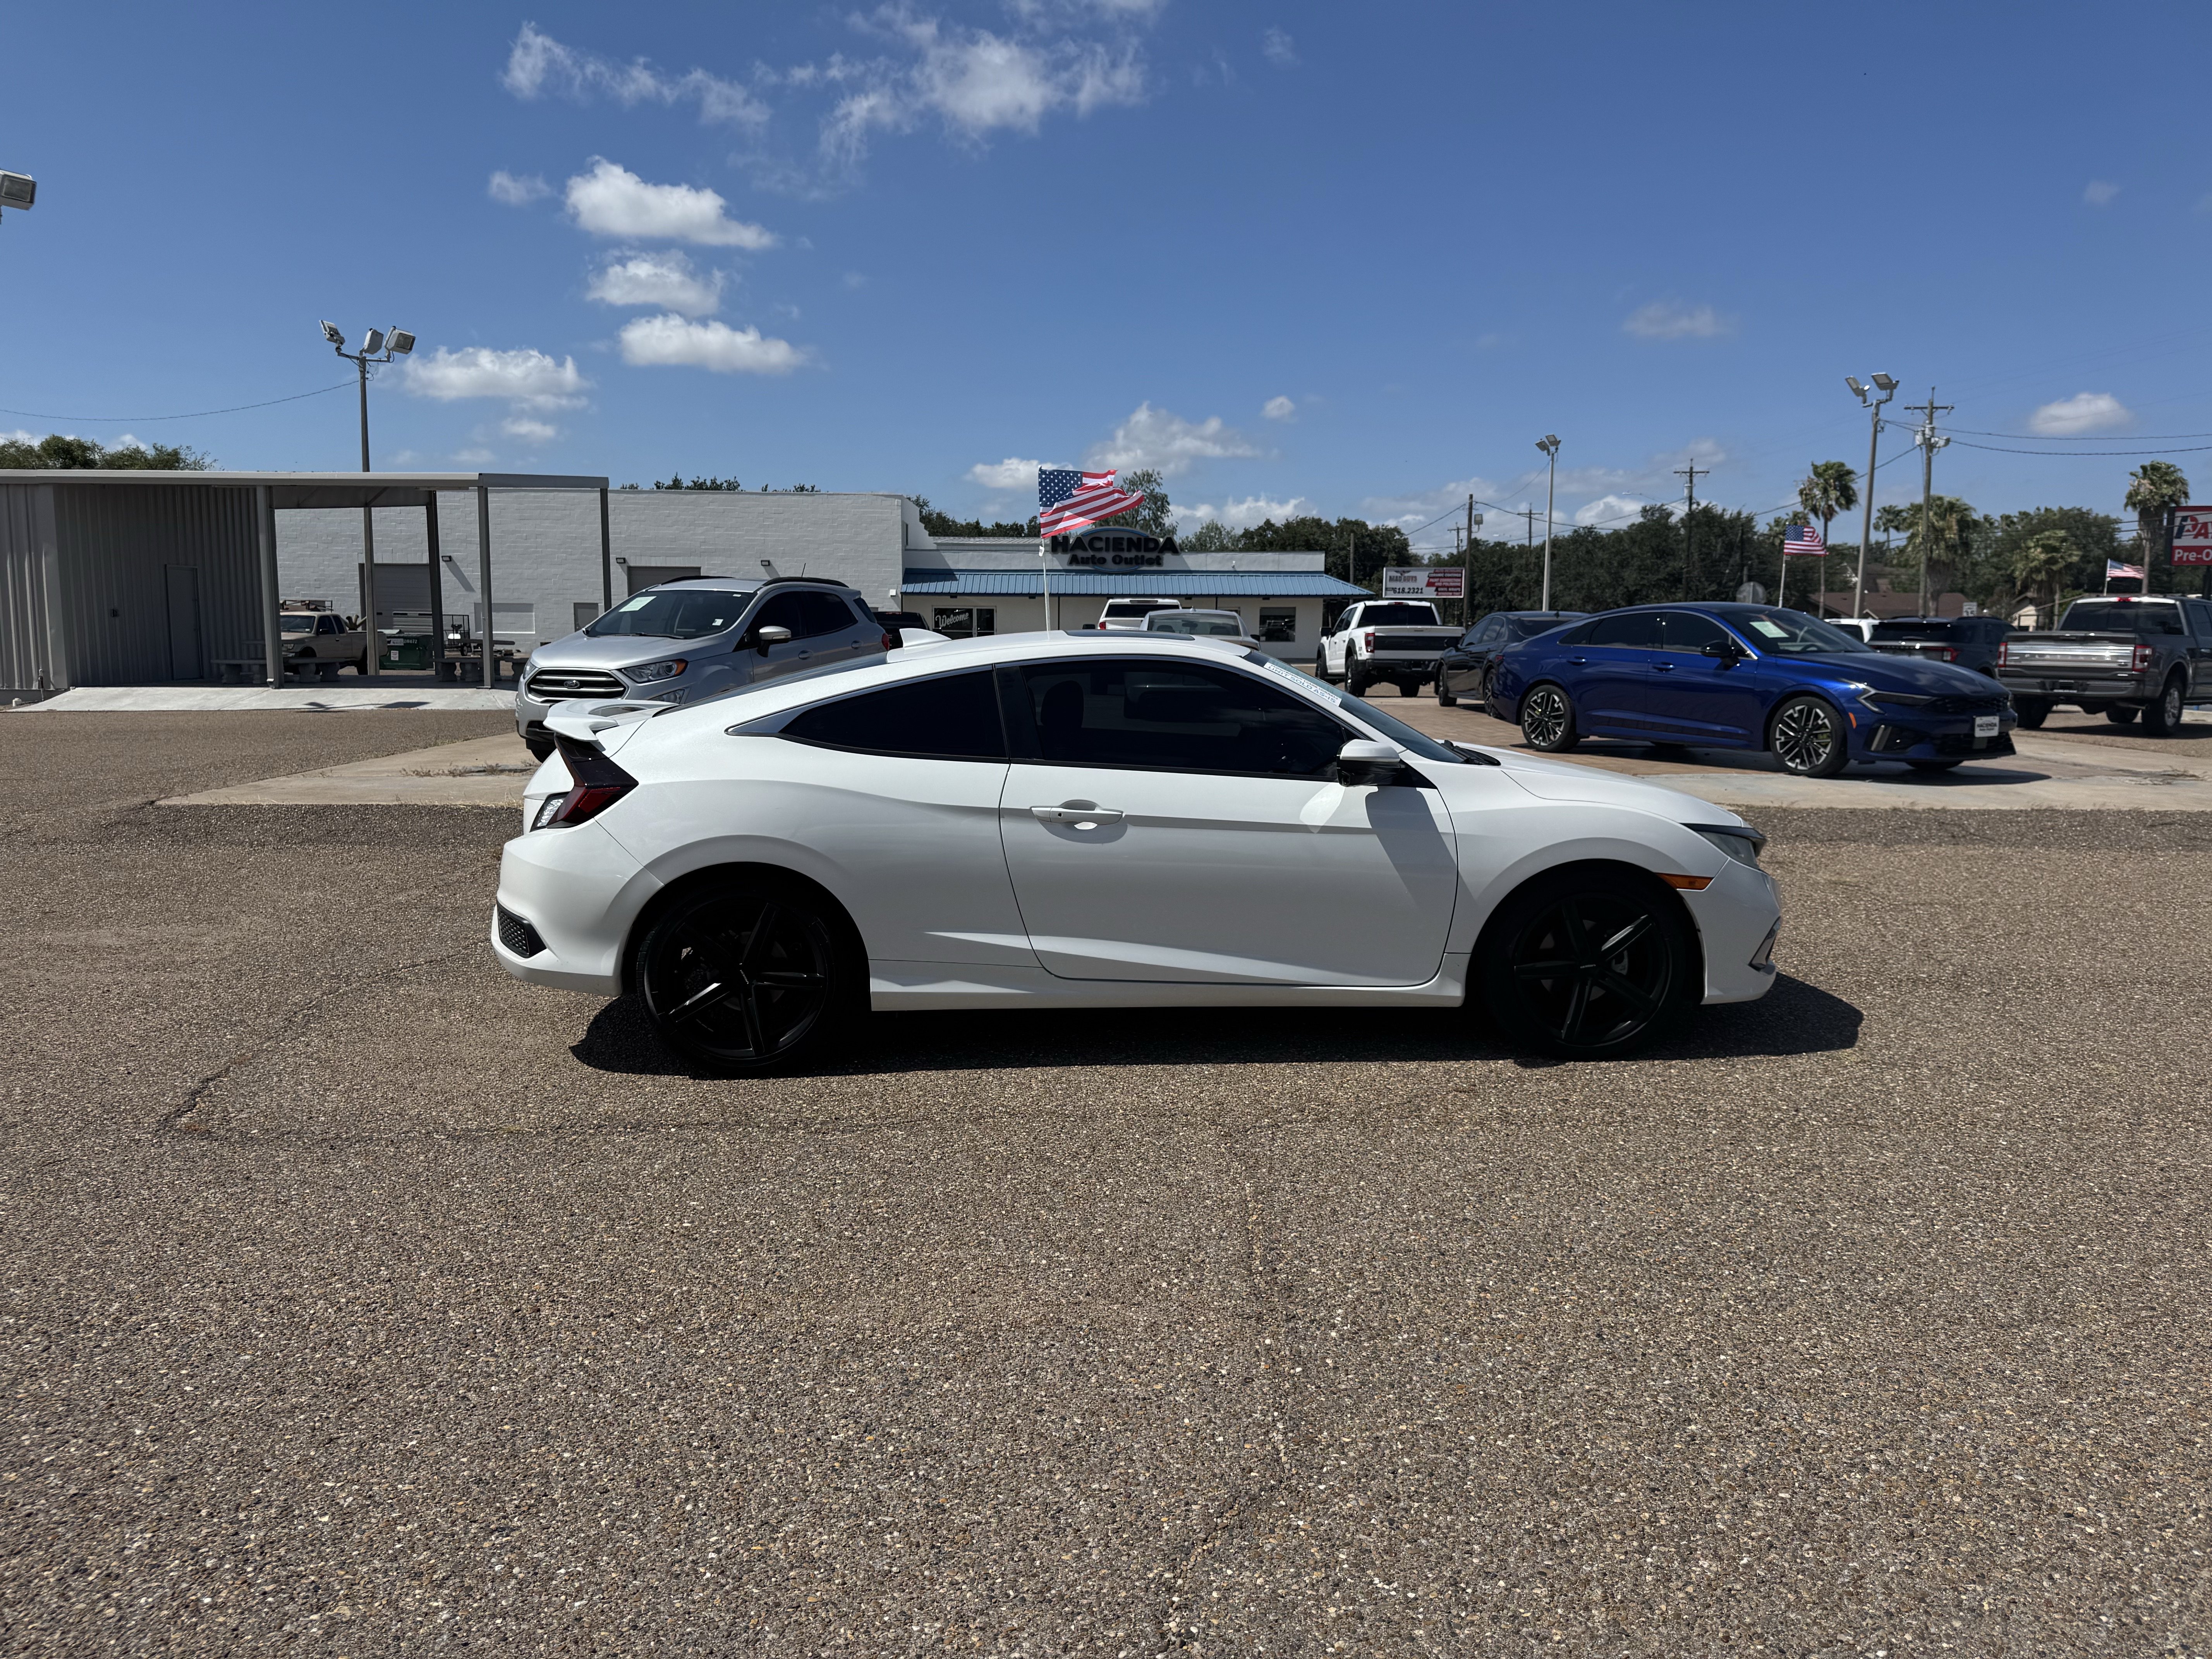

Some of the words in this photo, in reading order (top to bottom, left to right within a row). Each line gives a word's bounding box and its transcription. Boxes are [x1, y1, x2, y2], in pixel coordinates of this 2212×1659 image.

[2174, 515, 2212, 539] PA
[1051, 536, 1180, 553] HACIENDA
[1069, 554, 1107, 565] Auto
[1112, 554, 1162, 565] Outlet
[2174, 549, 2212, 561] Pre-O
[935, 613, 969, 627] Welcome
[1268, 666, 1290, 677] UNIT
[1290, 677, 1312, 690] SOLD
[1313, 689, 1336, 704] AS-IS
